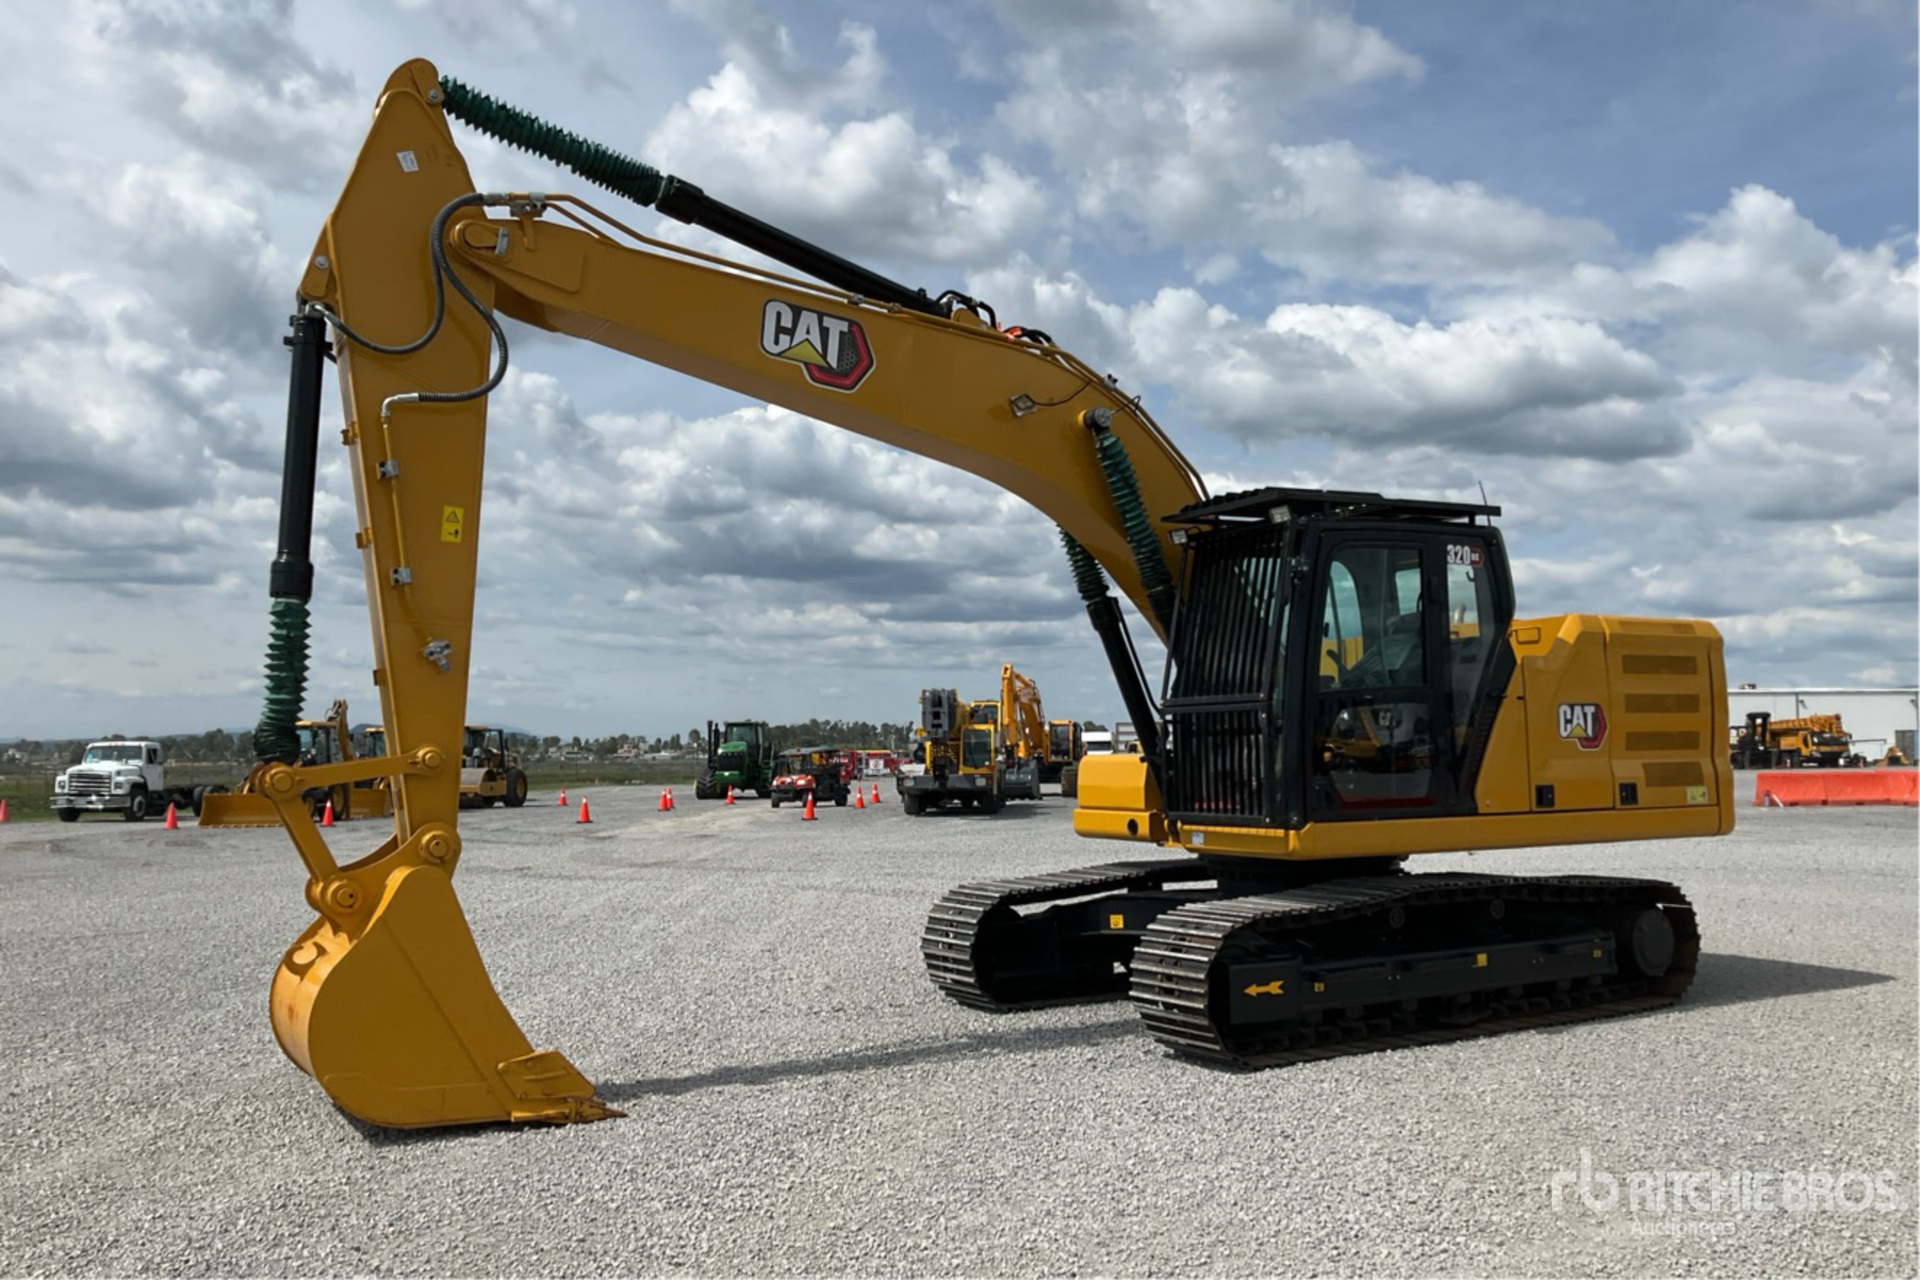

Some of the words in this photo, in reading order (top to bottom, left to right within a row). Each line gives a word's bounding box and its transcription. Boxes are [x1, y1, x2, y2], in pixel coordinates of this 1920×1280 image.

[763, 301, 849, 369] CAT
[1447, 544, 1471, 565] 320
[1559, 704, 1596, 738] CAT
